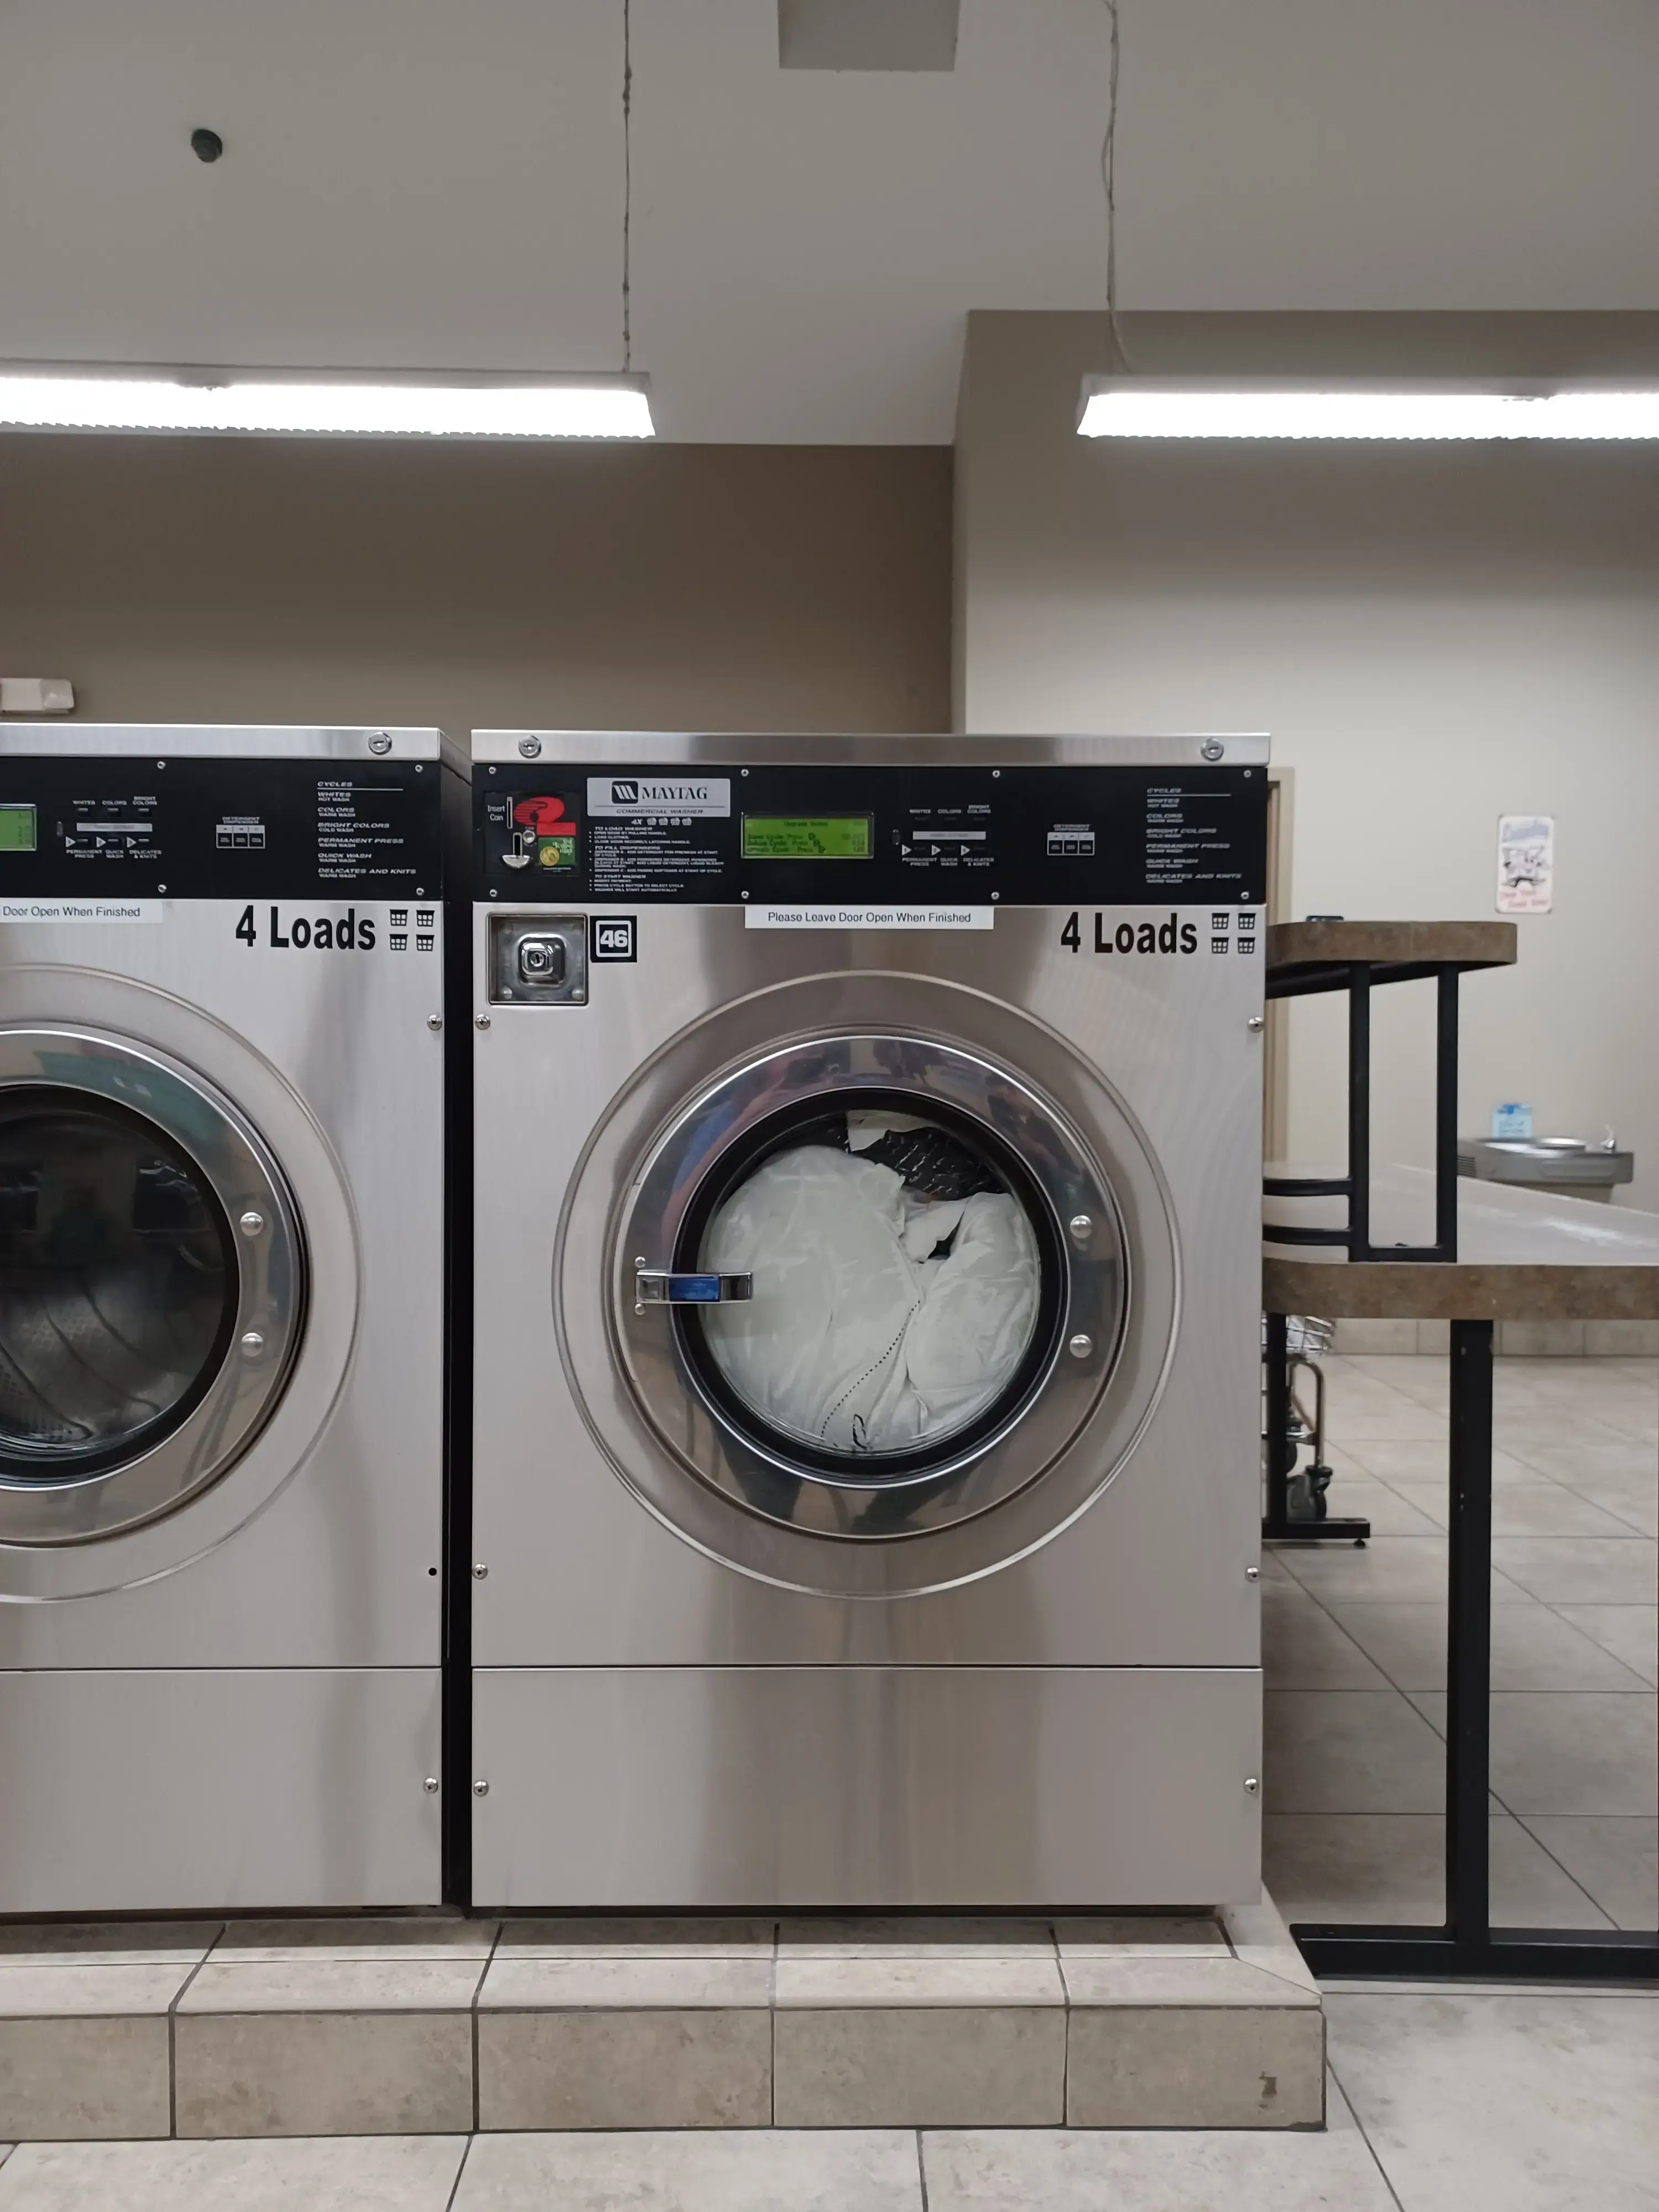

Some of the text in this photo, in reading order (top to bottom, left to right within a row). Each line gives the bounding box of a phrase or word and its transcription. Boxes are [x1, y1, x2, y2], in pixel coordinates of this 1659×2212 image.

[641, 786, 707, 800] MAYTAG
[3, 906, 140, 918] Door Open When Finished
[768, 912, 971, 925] Please Leave Door Open When Finished
[236, 905, 376, 951] 4 Loads
[1061, 911, 1198, 954] 4 Loads
[600, 930, 628, 947] 46
